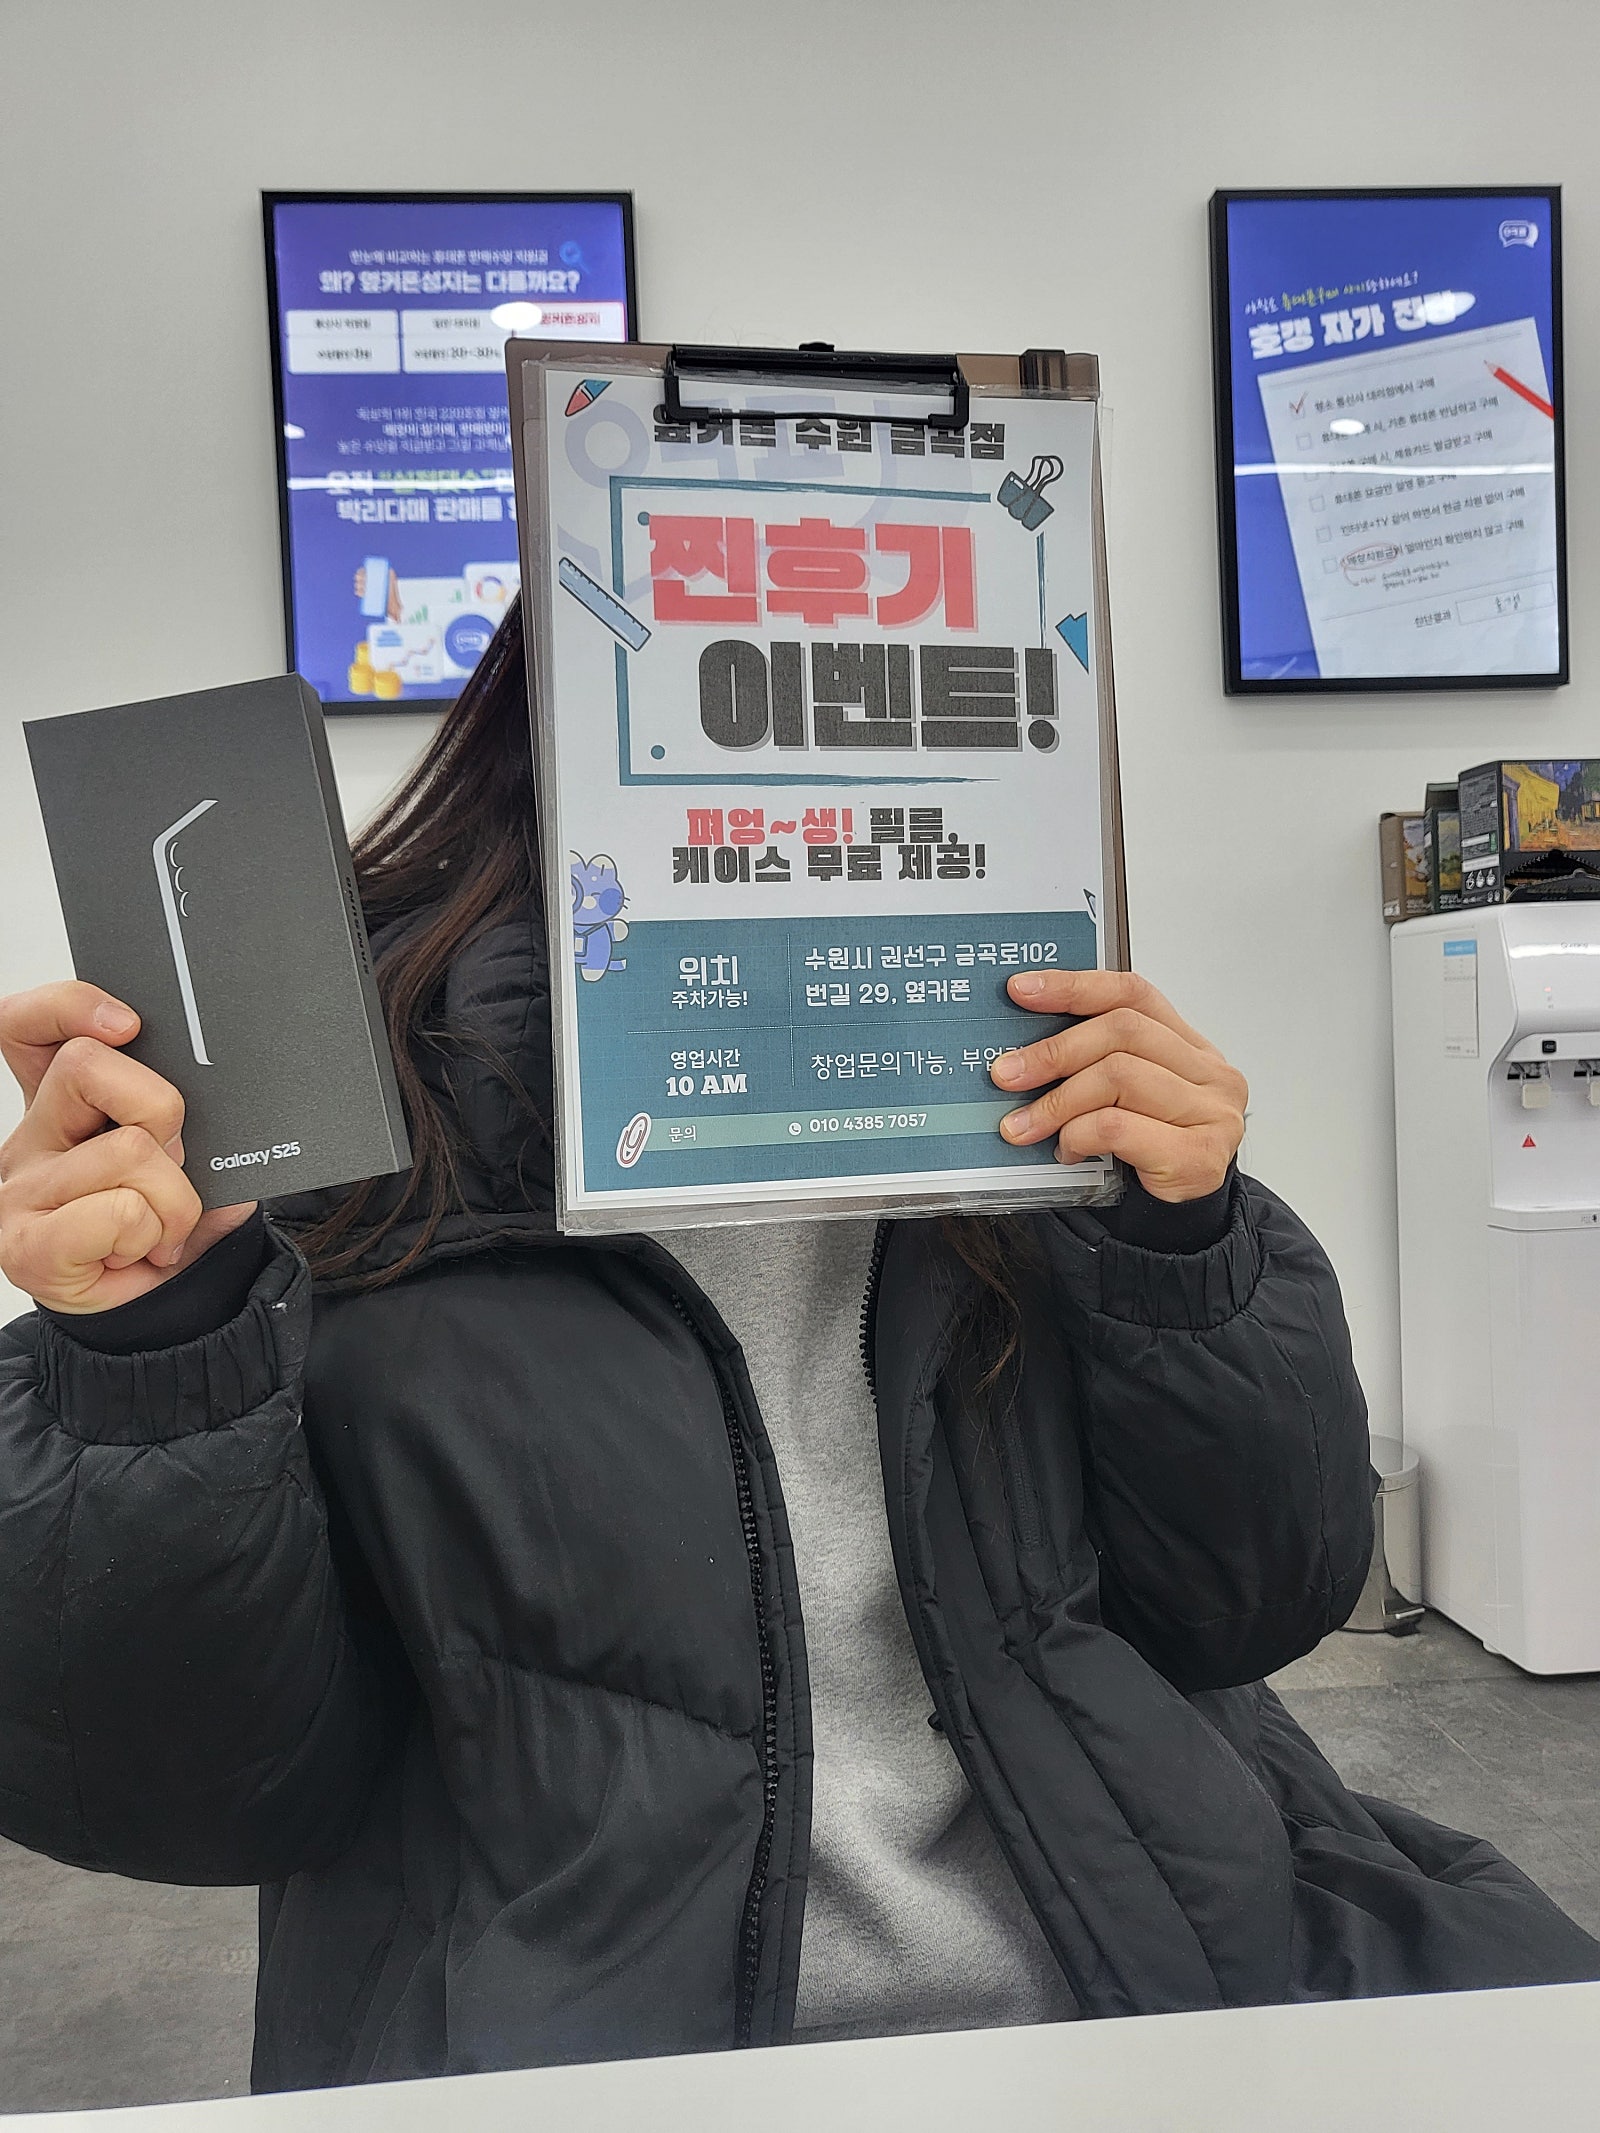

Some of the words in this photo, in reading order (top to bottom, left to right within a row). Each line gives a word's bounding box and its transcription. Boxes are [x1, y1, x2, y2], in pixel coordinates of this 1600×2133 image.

[319, 271, 356, 294] 왜?
[485, 270, 581, 294] 다를까요?
[1248, 316, 1315, 361] 호갱
[1320, 303, 1386, 347] 자가
[796, 417, 873, 453] 수원
[337, 496, 430, 523] 박리다매
[649, 515, 978, 633] 찐후기
[699, 639, 1060, 753] 이벤트!
[687, 807, 854, 847] 퍼엉~생!
[869, 807, 958, 847] 필름,
[671, 844, 792, 885] 케이스
[807, 845, 882, 883] 무료
[897, 843, 987, 881] 제공!
[678, 954, 740, 987] 위치
[804, 946, 873, 972] 수원시
[880, 944, 948, 970] 권선구
[955, 941, 1059, 966] 금곡로102
[671, 989, 748, 1010] 주차가능!
[805, 981, 851, 1007] 번길
[859, 982, 897, 1006] 29,
[904, 979, 971, 1005] 옆커폰
[669, 1048, 741, 1070] 영업시간
[810, 1050, 954, 1082] 창업문의가능,
[961, 1045, 1024, 1072] 부업
[666, 1075, 693, 1097] 10
[700, 1073, 748, 1095] AM
[668, 1124, 697, 1143] 문의
[809, 1115, 841, 1133] 010
[843, 1113, 884, 1131] 4385
[886, 1112, 928, 1130] 7057
[210, 1150, 270, 1173] Galaxy
[271, 1140, 301, 1161] S25
